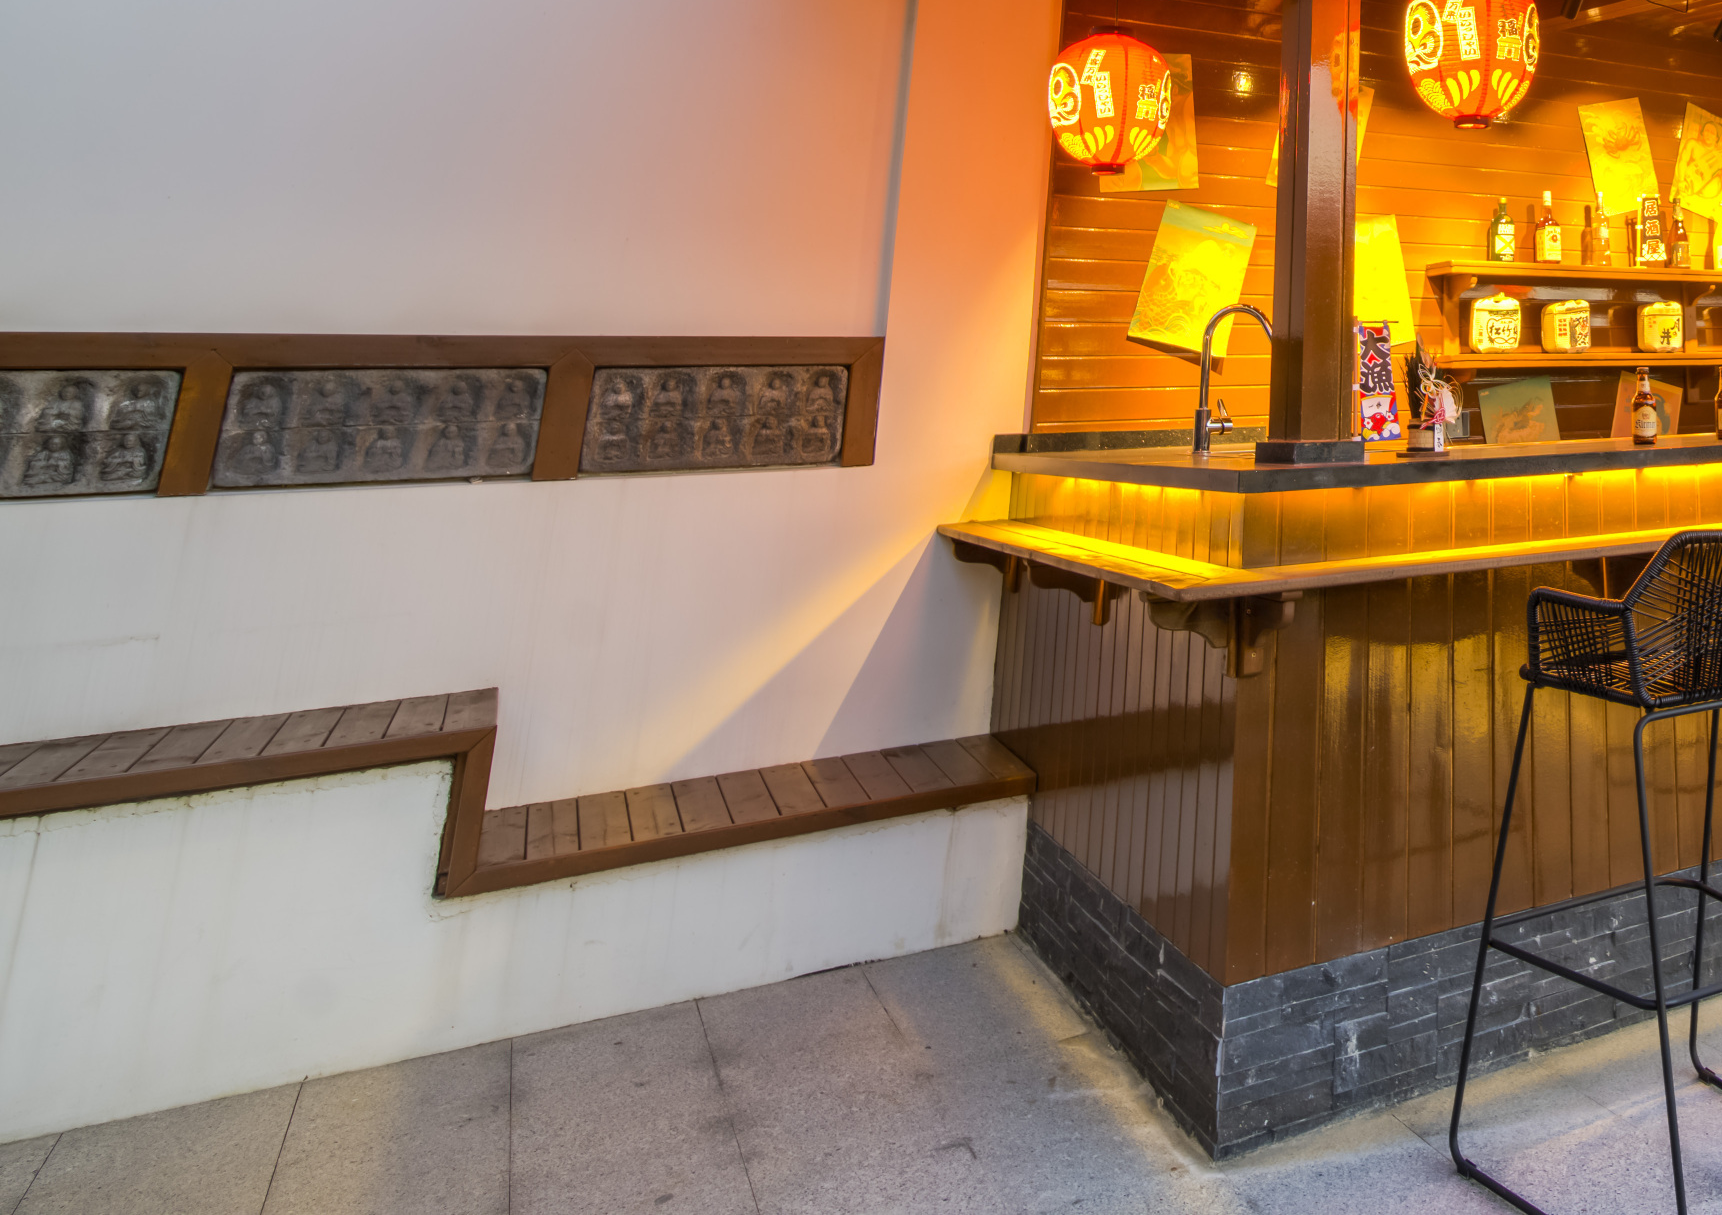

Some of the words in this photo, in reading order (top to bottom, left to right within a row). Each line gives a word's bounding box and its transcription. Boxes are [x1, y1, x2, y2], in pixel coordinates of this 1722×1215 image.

[1497, 18, 1518, 38] 福
[1138, 84, 1157, 100] 福
[1643, 199, 1662, 256] 居酒屋
[1359, 329, 1395, 394] 大漁
